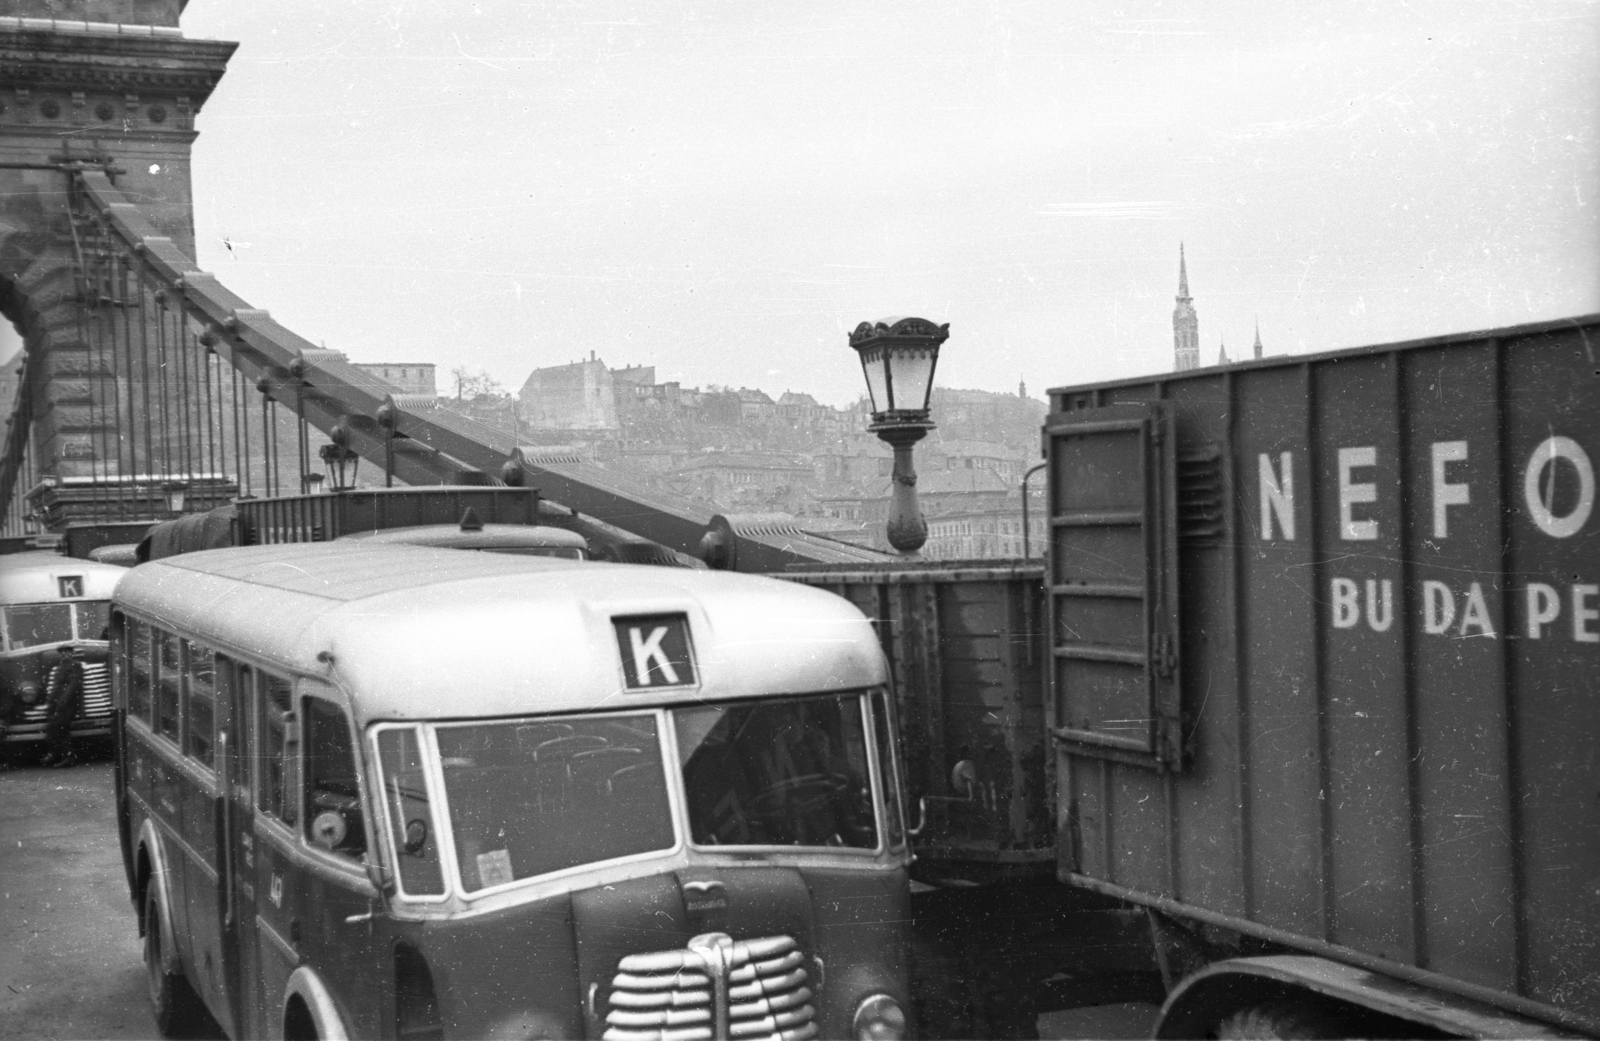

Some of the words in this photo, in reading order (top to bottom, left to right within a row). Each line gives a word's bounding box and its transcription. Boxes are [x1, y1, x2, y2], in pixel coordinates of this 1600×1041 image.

[1259, 436, 1595, 541] NEFO
[64, 580, 78, 597] K
[1331, 577, 1600, 642] BUDAPE
[629, 626, 679, 685] K
